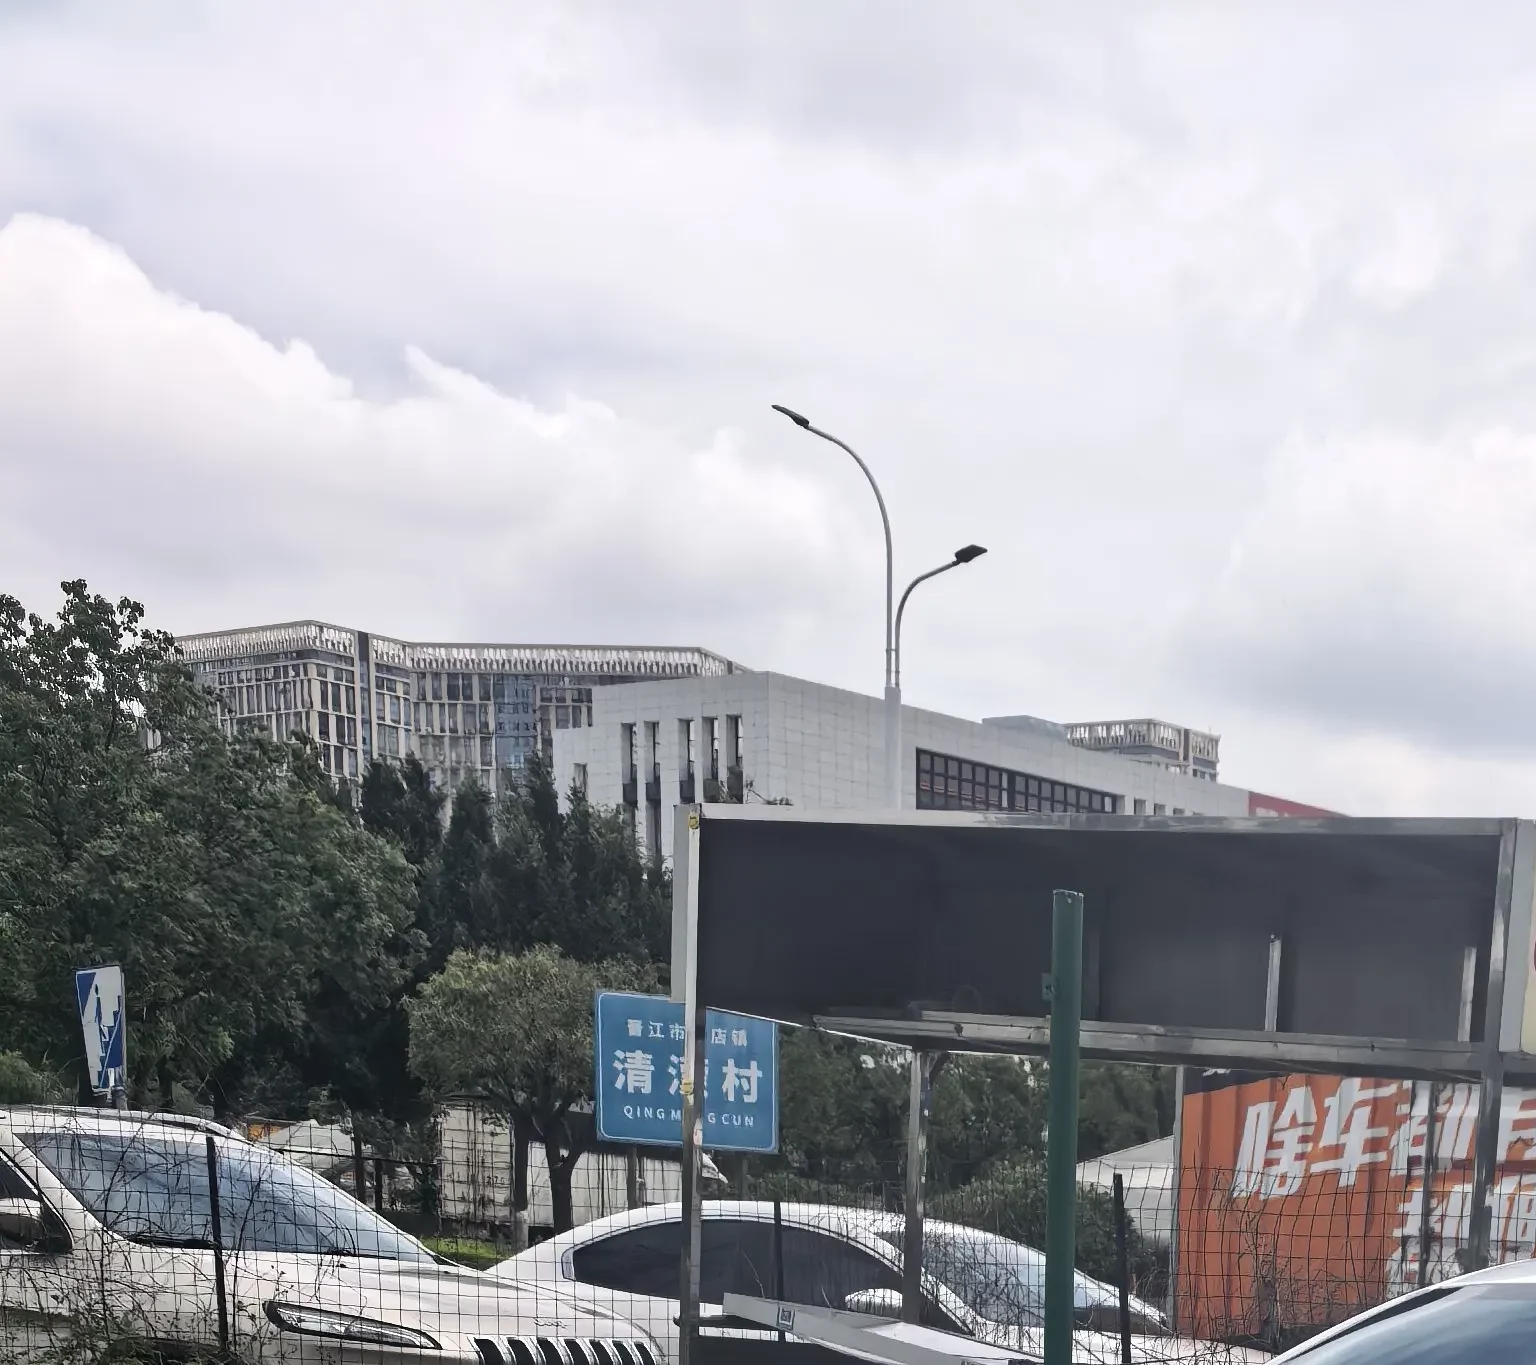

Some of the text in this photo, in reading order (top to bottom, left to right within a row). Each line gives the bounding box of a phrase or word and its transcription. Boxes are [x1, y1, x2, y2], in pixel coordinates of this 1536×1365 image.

[628, 1019, 748, 1046] 晋江市店镇
